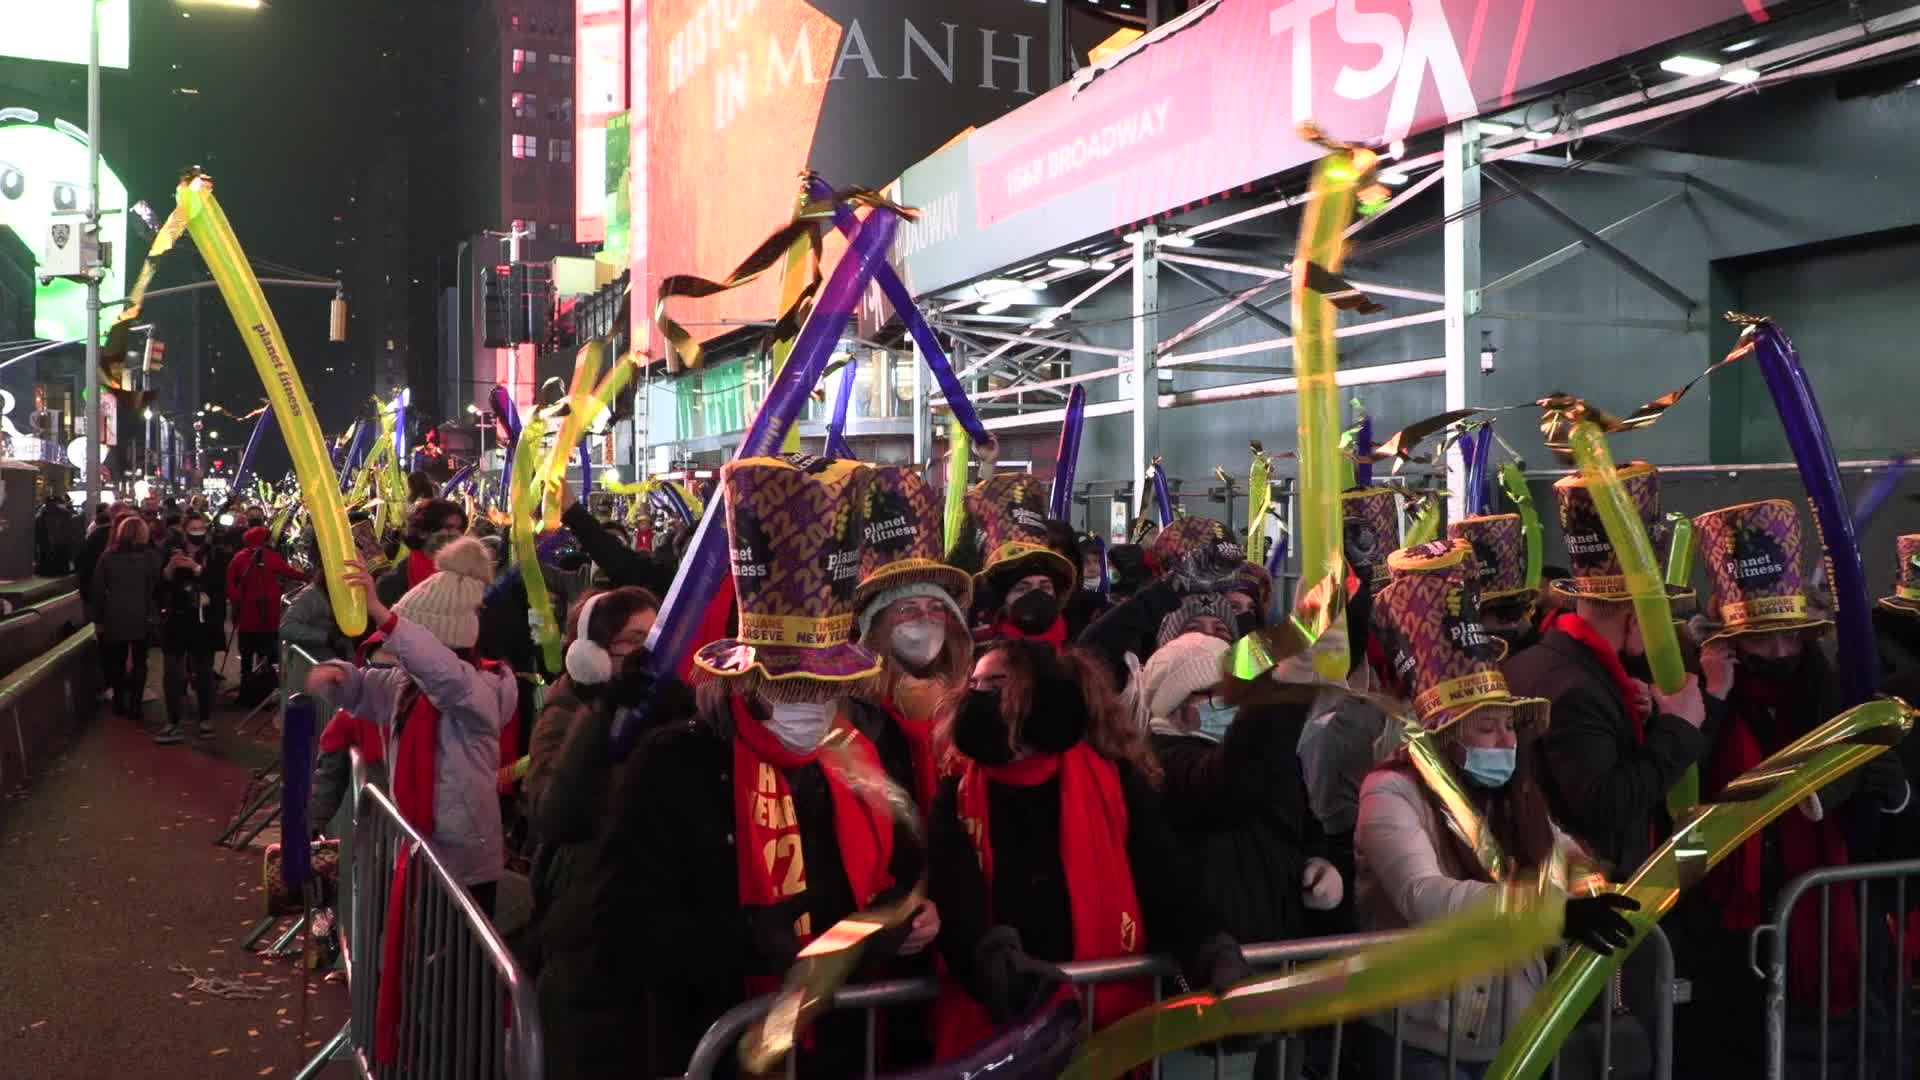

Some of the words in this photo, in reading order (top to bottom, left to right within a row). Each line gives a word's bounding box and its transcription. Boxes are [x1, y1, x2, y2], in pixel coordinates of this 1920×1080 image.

[764, 18, 1081, 96] MANH
[1047, 97, 1169, 179] BROADWAY
[252, 323, 285, 369] planet
[278, 371, 303, 417] fitness
[864, 516, 906, 540] planet
[871, 526, 918, 545] fitness
[1727, 554, 1772, 574] planet
[1734, 563, 1782, 579] fitness
